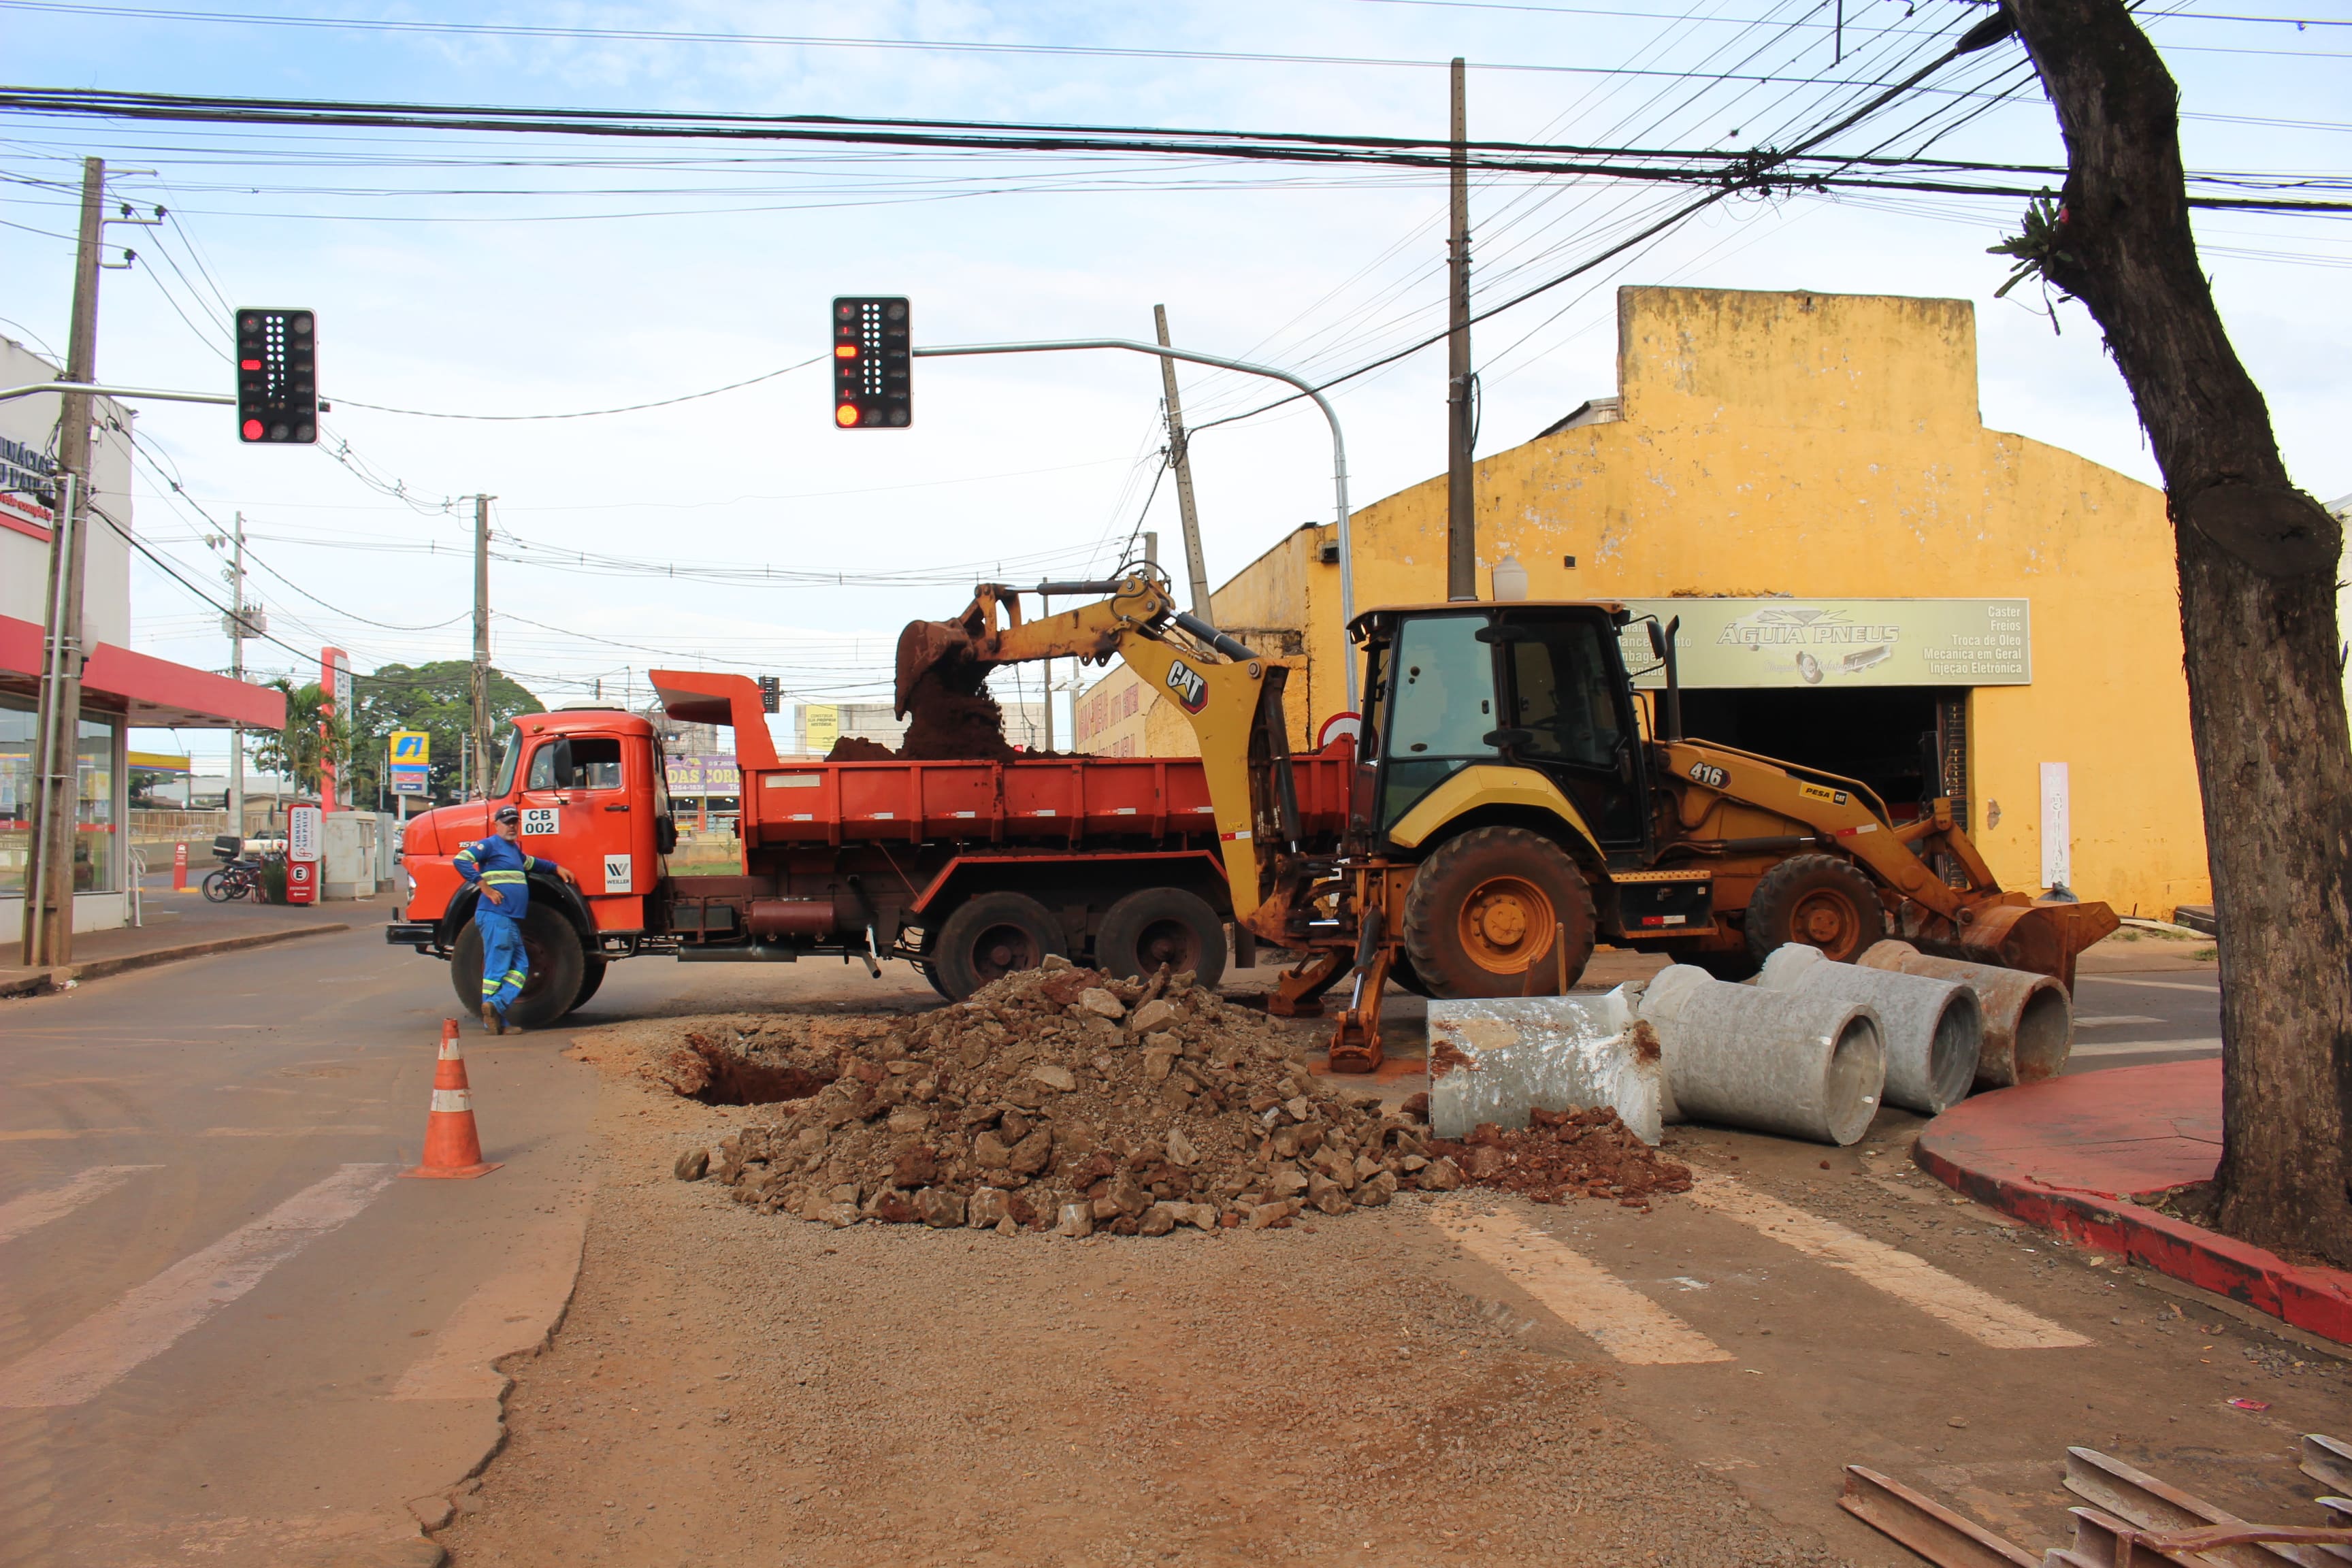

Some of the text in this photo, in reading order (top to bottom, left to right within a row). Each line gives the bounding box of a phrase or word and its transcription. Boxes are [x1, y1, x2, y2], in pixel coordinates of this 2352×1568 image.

[1988, 606, 2021, 617] Caster
[1991, 620, 2021, 631] Freios
[1716, 623, 1899, 644] ÁGUIA PNEUS
[1952, 634, 1980, 645] Troca
[1984, 634, 1995, 645] de
[1977, 650, 1992, 659] em
[1995, 648, 2021, 659] Geral
[1930, 662, 1967, 676] Injeção
[1167, 660, 1204, 703] CAT
[1690, 762, 1723, 786] 416
[1806, 787, 1830, 798] PESA
[529, 810, 551, 821] CB
[525, 822, 555, 834] 002
[296, 869, 303, 879] E
